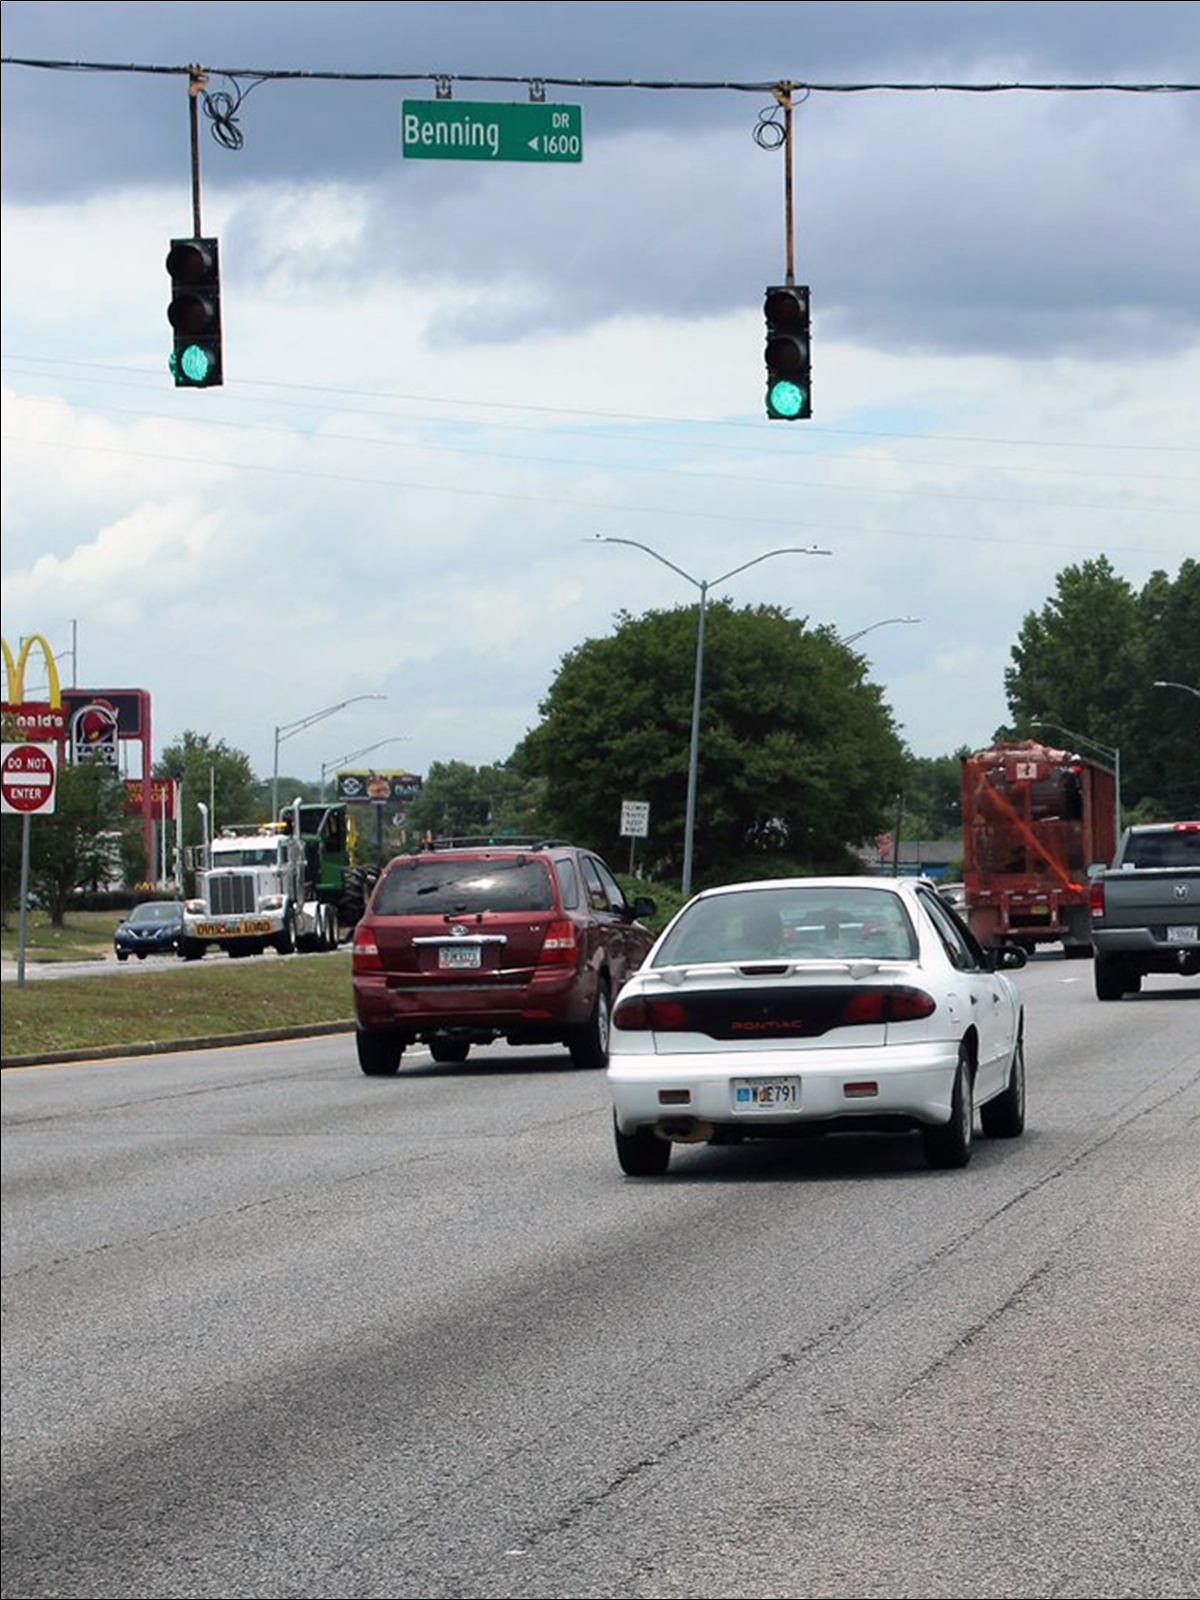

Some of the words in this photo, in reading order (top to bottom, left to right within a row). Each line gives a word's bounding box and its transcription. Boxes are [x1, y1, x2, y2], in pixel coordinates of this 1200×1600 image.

[552, 112, 570, 129] DR
[404, 114, 499, 156] Benning
[542, 135, 580, 154] 1600
[8, 757, 22, 769] DO
[27, 757, 47, 769] NOT
[11, 788, 41, 799] ENTER
[731, 1019, 803, 1030] PONTIAC
